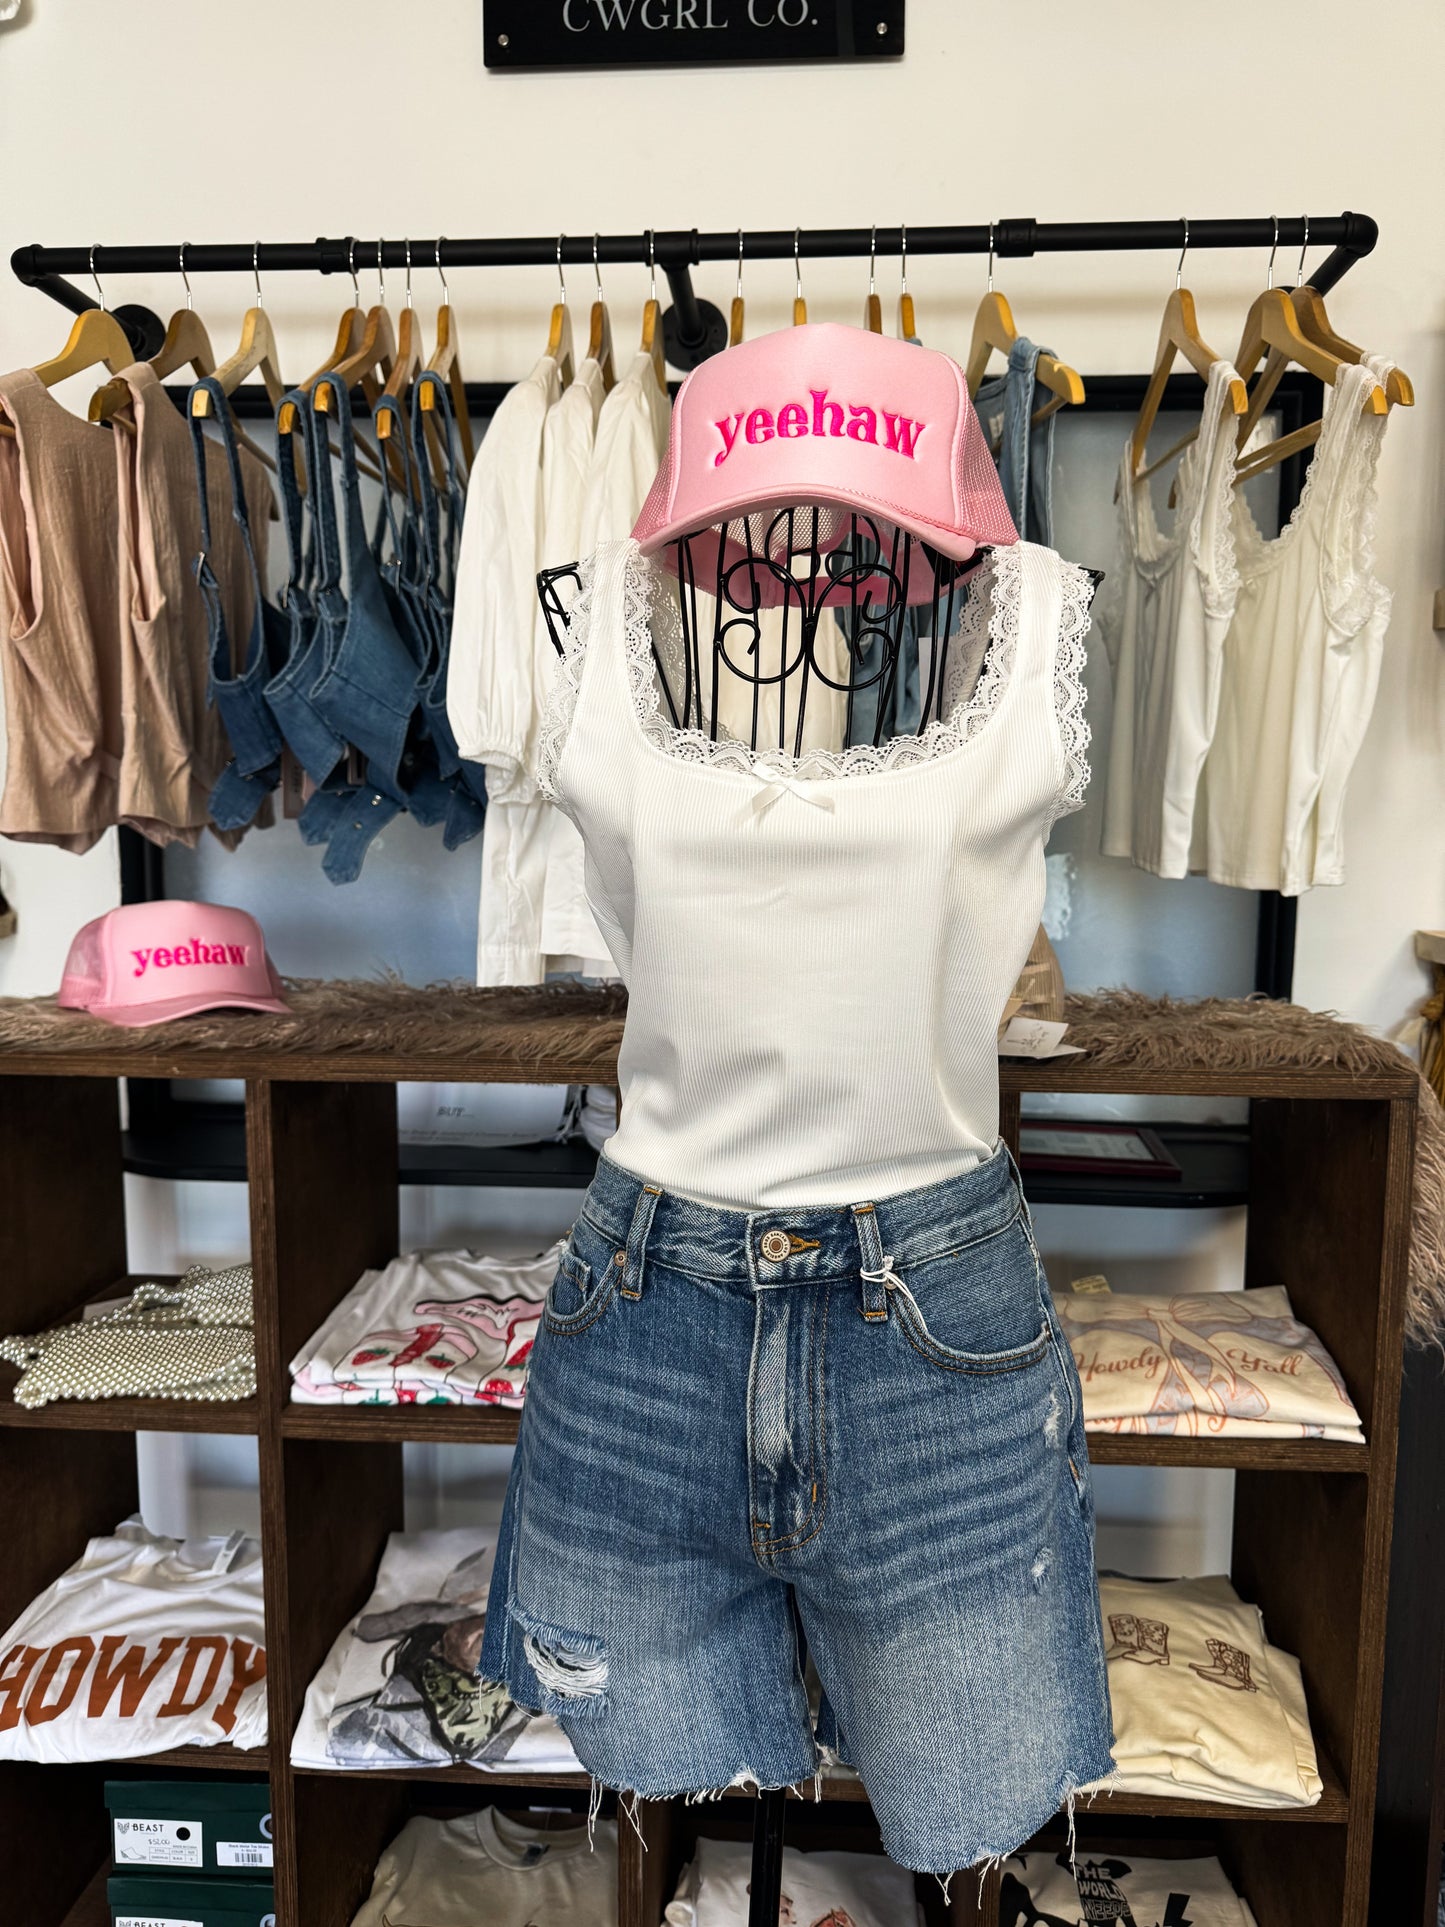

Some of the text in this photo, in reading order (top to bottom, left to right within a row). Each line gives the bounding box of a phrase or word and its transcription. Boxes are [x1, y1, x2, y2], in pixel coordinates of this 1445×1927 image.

[562, 0, 819, 32] CWGRL CO.
[714, 389, 926, 467] yeehaw
[131, 938, 249, 977] yeehaw
[1074, 1346, 1162, 1382] Howdy
[0, 1635, 267, 1736] HOWDY
[132, 1823, 165, 1832] BEAST
[1071, 1866, 1111, 1879] THE
[1078, 1880, 1127, 1902] WORLD
